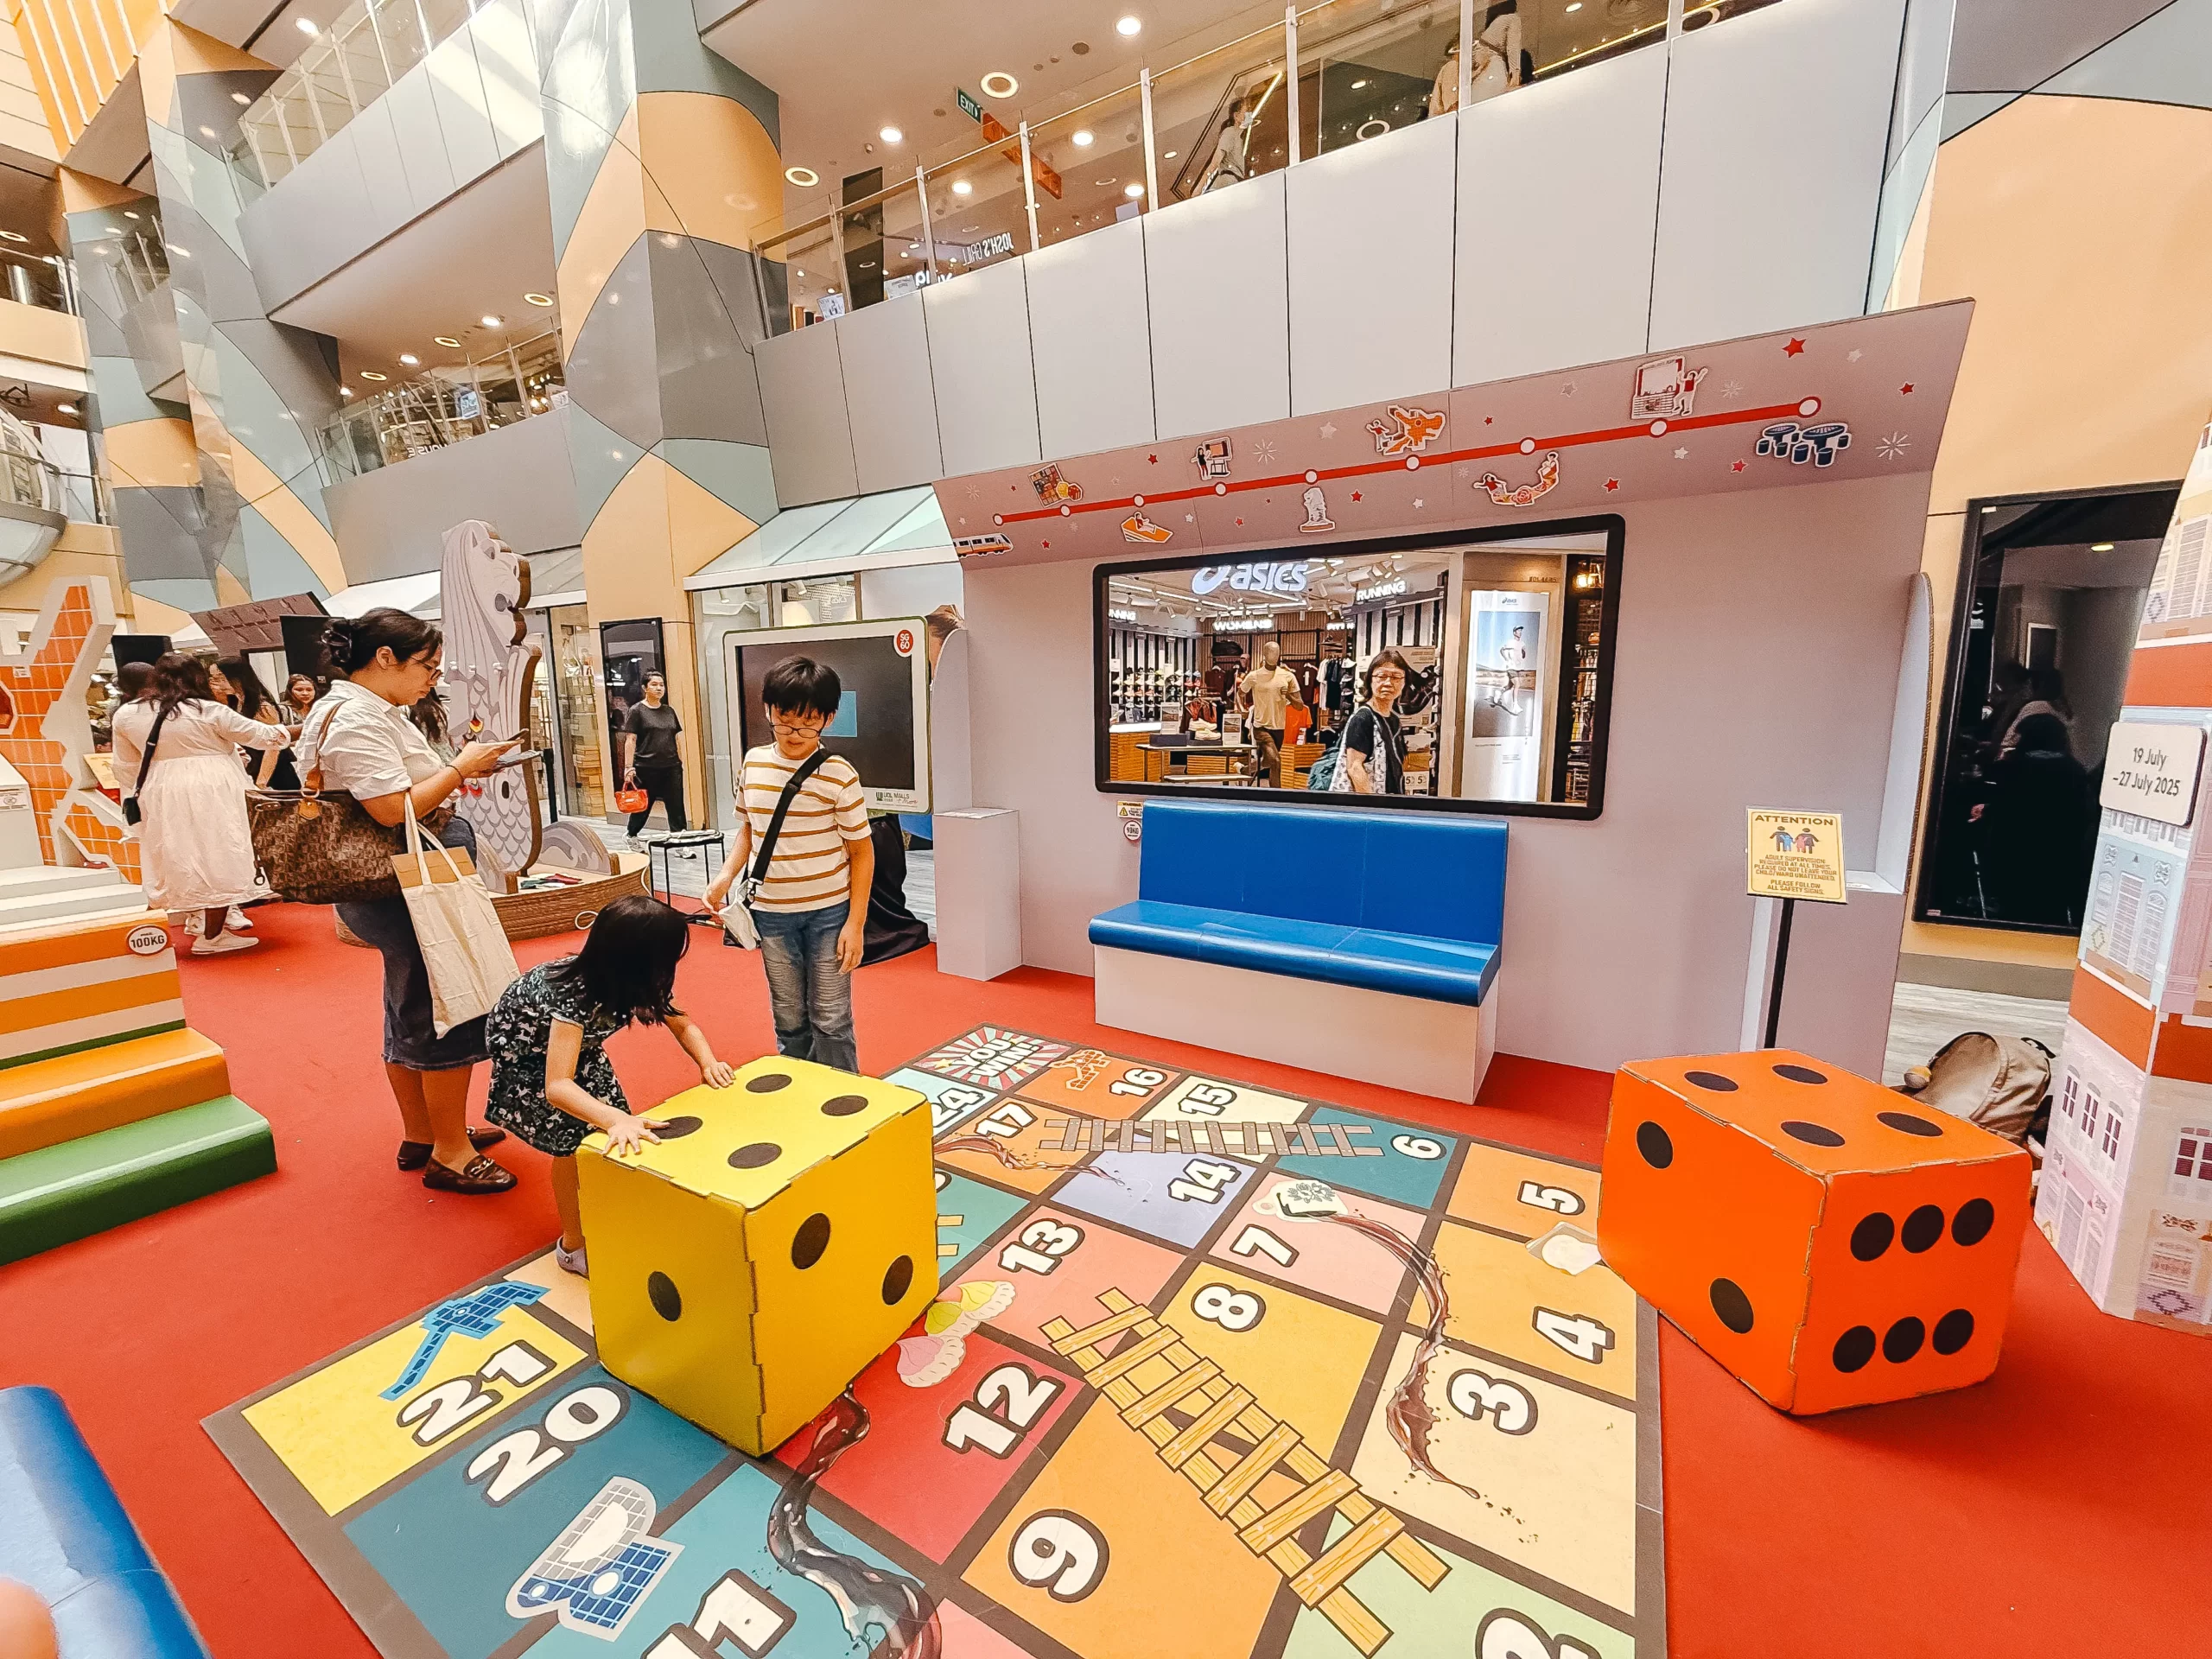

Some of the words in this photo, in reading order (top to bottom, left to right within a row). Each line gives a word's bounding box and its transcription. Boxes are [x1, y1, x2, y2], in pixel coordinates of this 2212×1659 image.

[960, 94, 975, 113] EXIT
[1230, 563, 1309, 591] asics
[1357, 581, 1408, 601] RUNNING
[1109, 608, 1136, 621] NNING
[2133, 747, 2144, 763] 19
[2145, 748, 2167, 771] July
[2131, 772, 2153, 796] July
[2153, 776, 2181, 796] 2025
[1755, 815, 1834, 826] ATTENTION
[1756, 869, 1794, 878] CHILD/WARD
[1784, 855, 1826, 864] SUPERVISION
[130, 934, 165, 949] 100KG
[950, 1038, 1014, 1068] YOU
[968, 1040, 1043, 1077] WIN!
[1109, 1068, 1168, 1097] 16
[1178, 1084, 1237, 1116] 15
[974, 1102, 1038, 1139] 17
[1389, 1134, 1447, 1160] 6
[1167, 1158, 1243, 1205] 14
[1517, 1180, 1586, 1216] 5
[998, 1217, 1085, 1275] 13
[1229, 1224, 1300, 1268] 7
[1191, 1282, 1267, 1333] 8
[1532, 1306, 1615, 1364] 4
[397, 1339, 557, 1447] 21
[1446, 1368, 1538, 1436] 3
[941, 1361, 1065, 1459] 12
[462, 1382, 632, 1508] 20
[1007, 1508, 1110, 1605] 9
